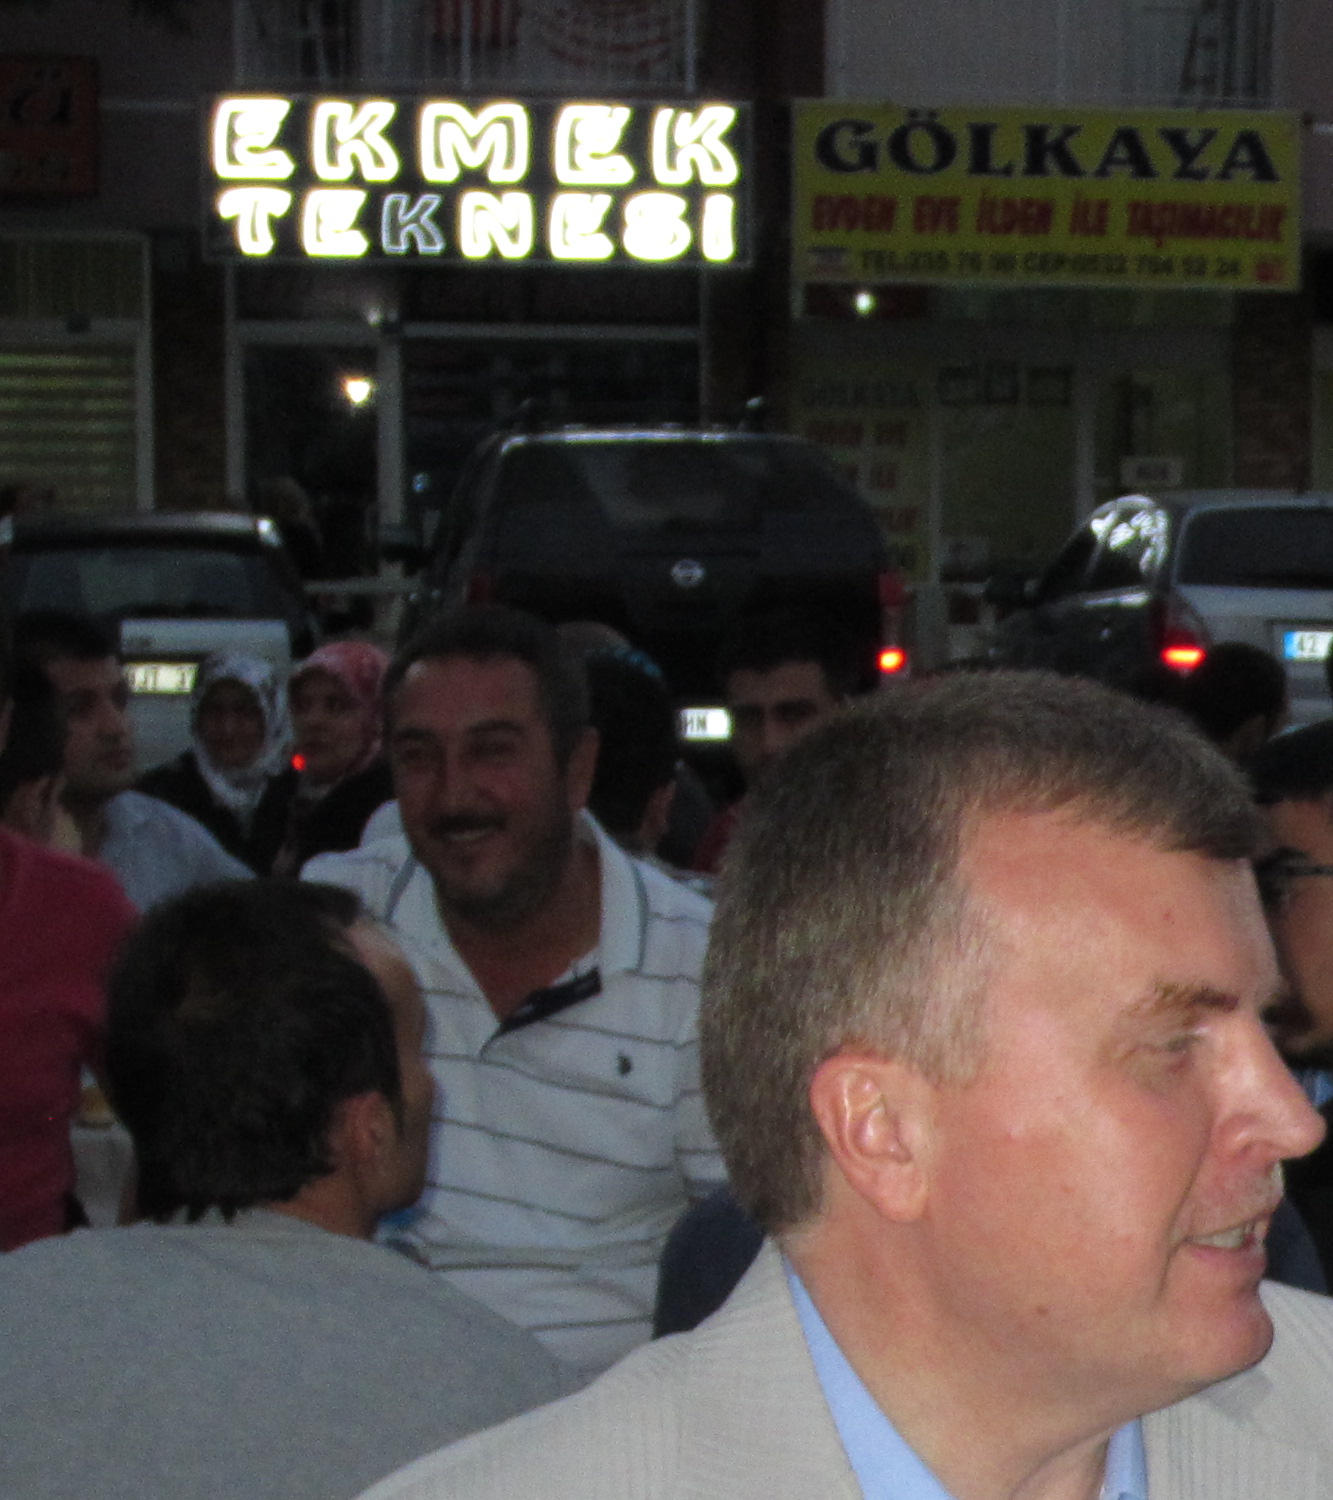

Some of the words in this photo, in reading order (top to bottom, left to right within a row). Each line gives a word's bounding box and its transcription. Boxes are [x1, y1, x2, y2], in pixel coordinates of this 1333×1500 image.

[213, 97, 738, 186] EKMEK
[814, 108, 1280, 183] GÖLKAYA
[912, 196, 962, 234] EVE
